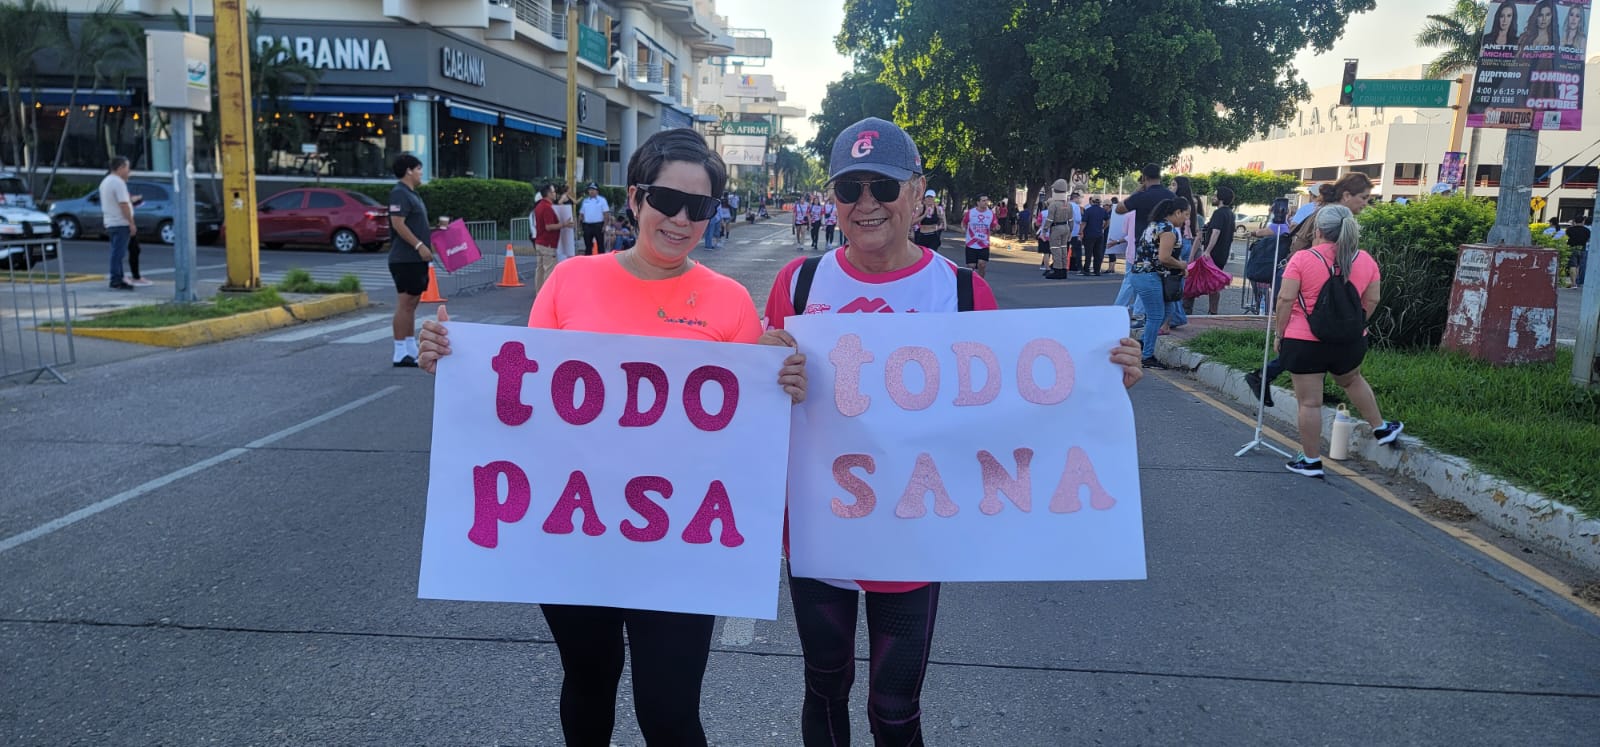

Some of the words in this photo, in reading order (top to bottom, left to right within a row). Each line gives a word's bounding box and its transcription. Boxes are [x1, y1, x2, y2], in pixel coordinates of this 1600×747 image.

[256, 35, 392, 71] CABANNA
[1483, 43, 1519, 51] ANETTE
[443, 46, 486, 88] CABANNA
[1479, 70, 1521, 79] AUDITORIO
[1530, 71, 1580, 84] DOMINGO
[1476, 87, 1492, 95] 4:00
[1516, 88, 1529, 96] PM
[1558, 84, 1579, 100] 12
[1526, 97, 1578, 109] OCTUBRE
[736, 125, 769, 135] AFIRME
[830, 445, 1117, 519] SANA
